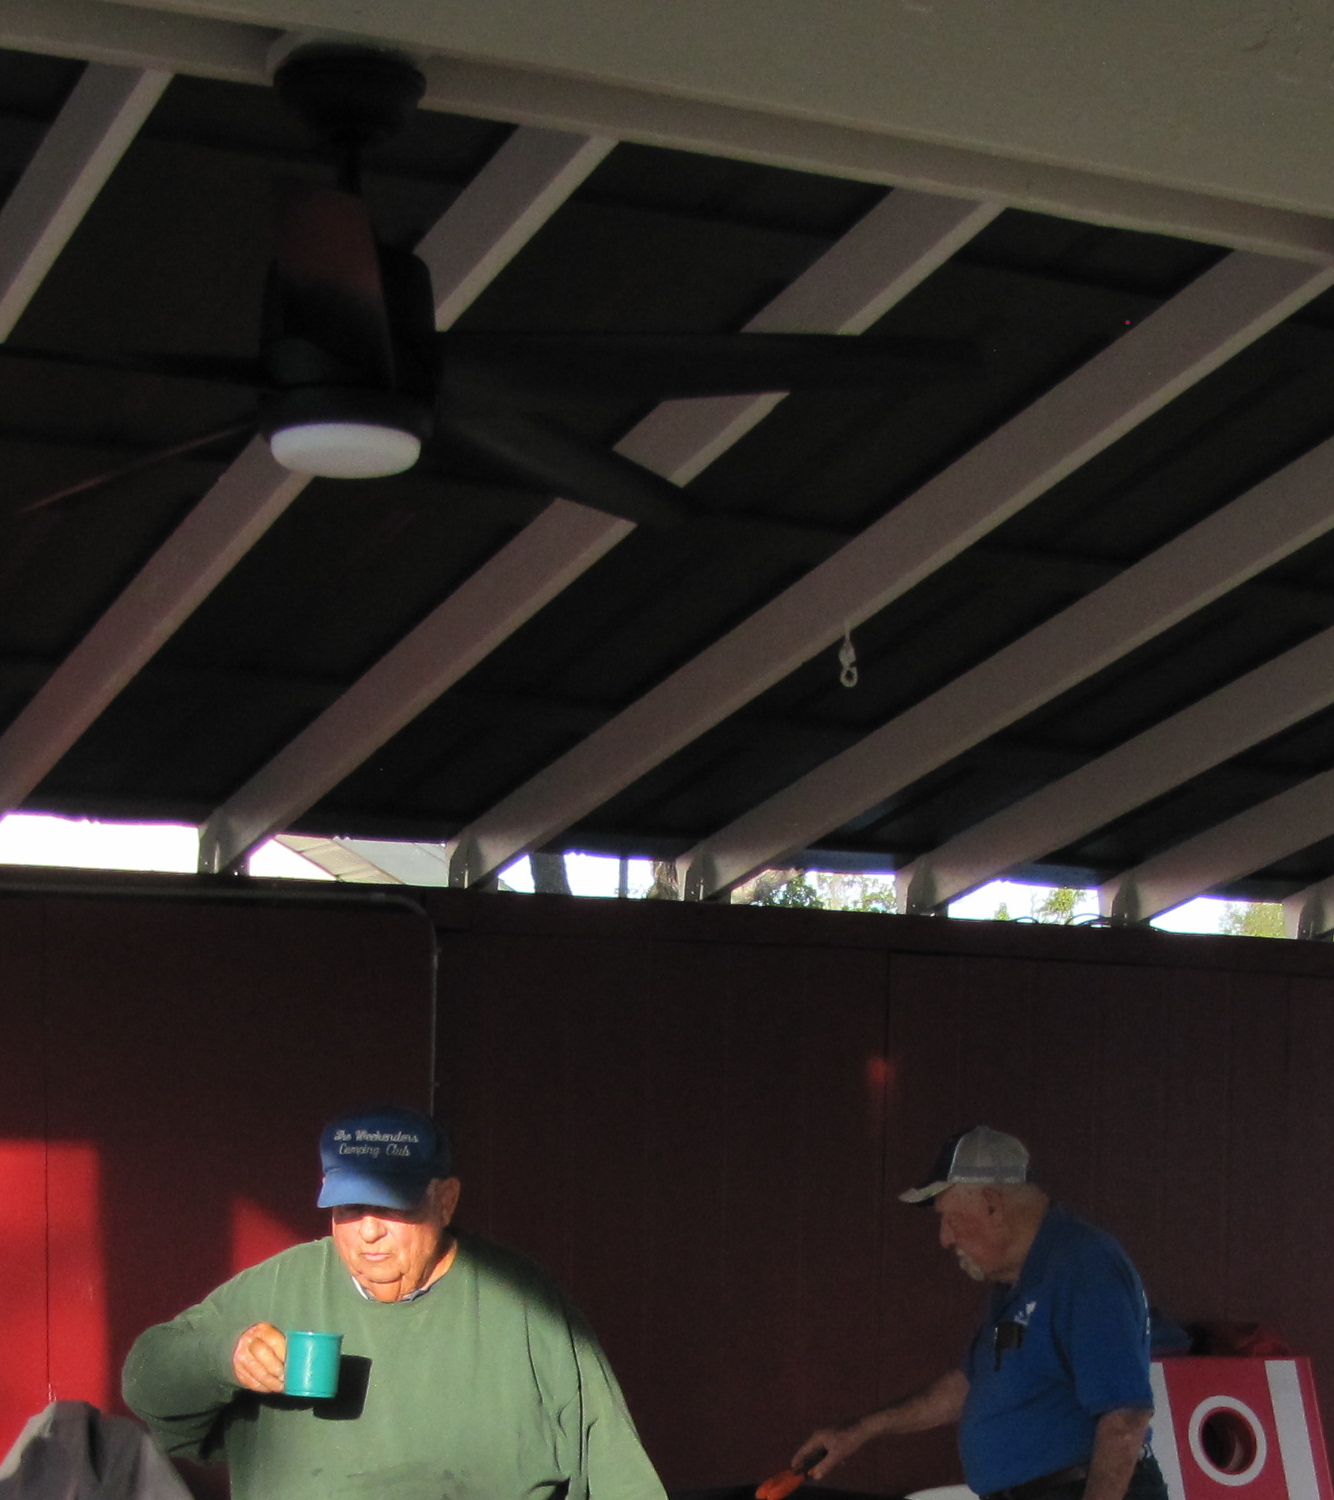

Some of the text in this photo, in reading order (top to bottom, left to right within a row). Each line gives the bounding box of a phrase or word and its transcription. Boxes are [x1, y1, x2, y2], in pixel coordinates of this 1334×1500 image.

[333, 1129, 419, 1144] The Weekenders
[338, 1142, 412, 1159] Camping Club
